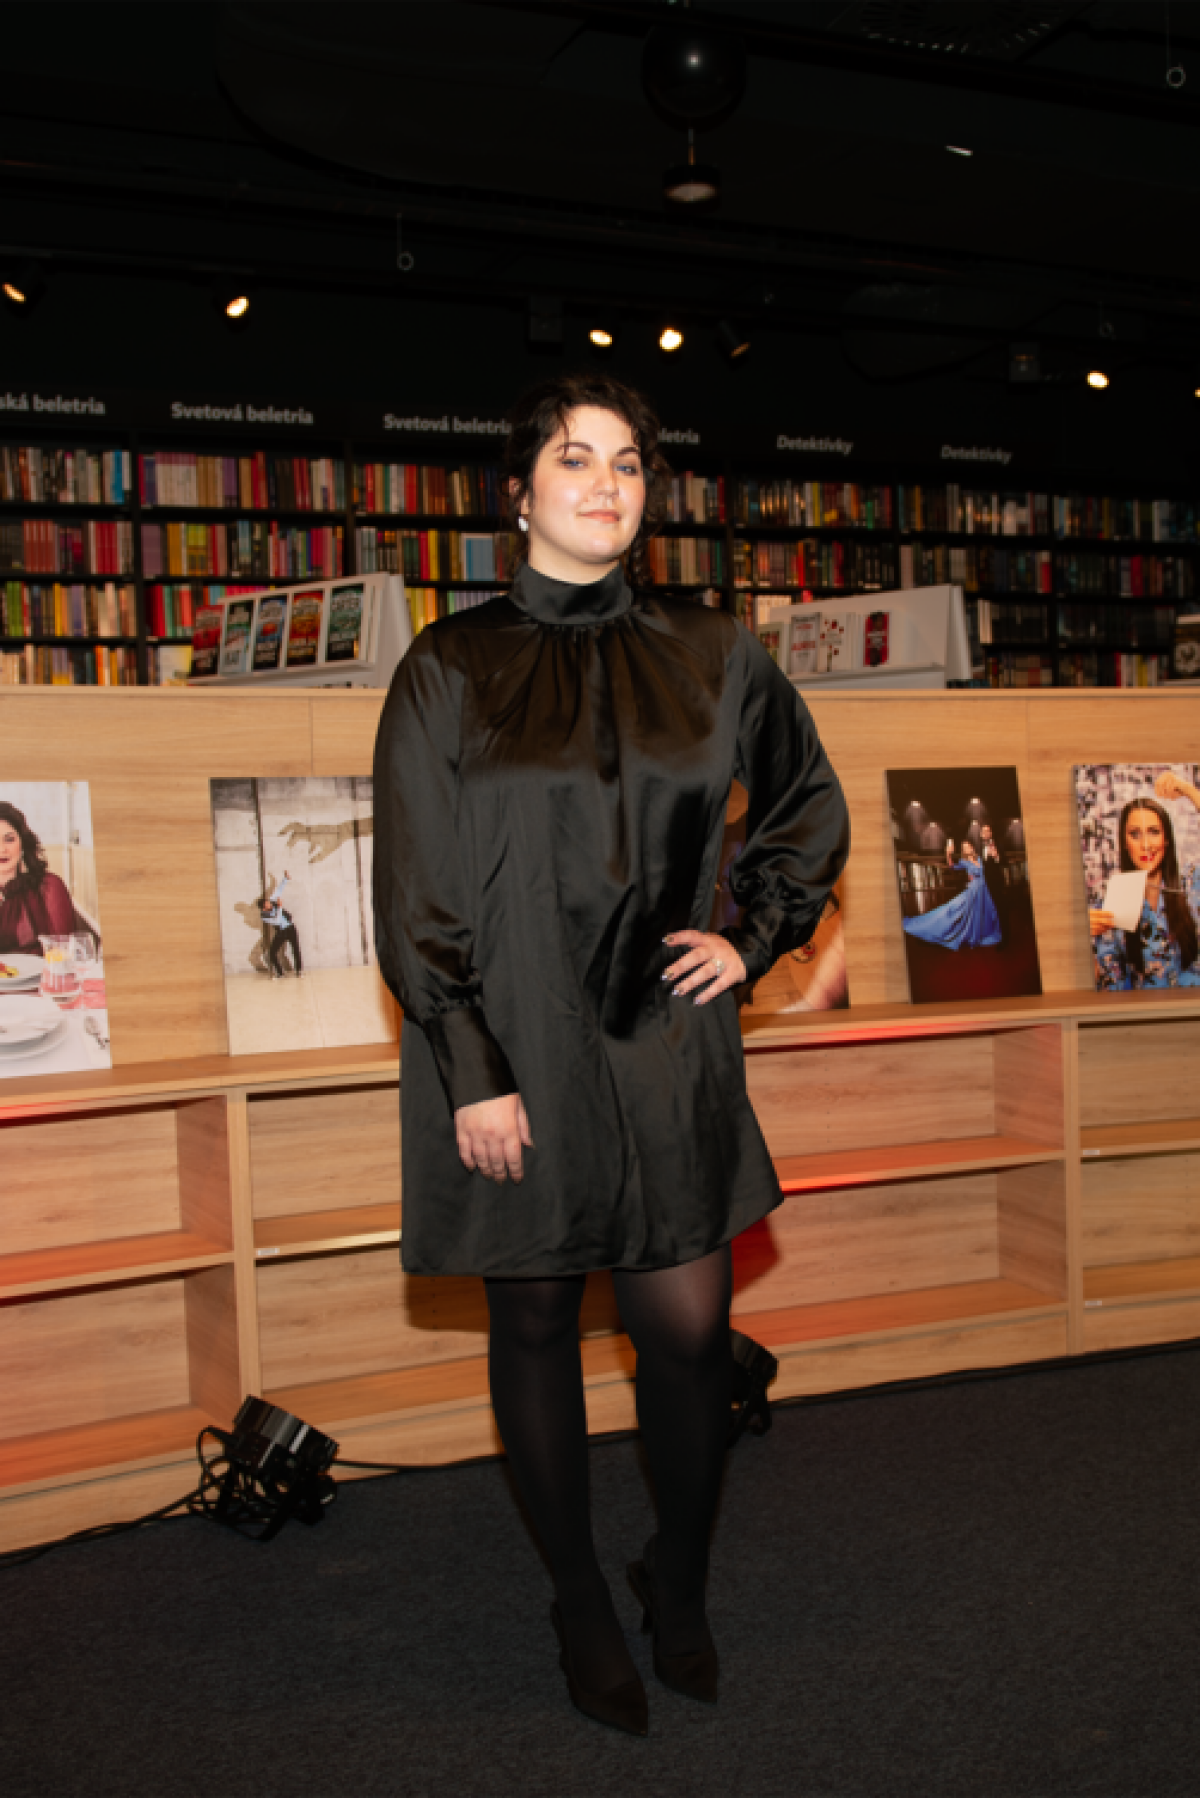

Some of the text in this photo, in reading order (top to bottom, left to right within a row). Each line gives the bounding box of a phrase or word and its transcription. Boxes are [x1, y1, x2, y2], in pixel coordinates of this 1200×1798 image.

[33, 394, 106, 415] beletria
[170, 401, 314, 425] Svetová beletria
[383, 413, 449, 432] Svetová
[777, 434, 853, 456] Detektívky
[941, 444, 1012, 465] Detektívky
